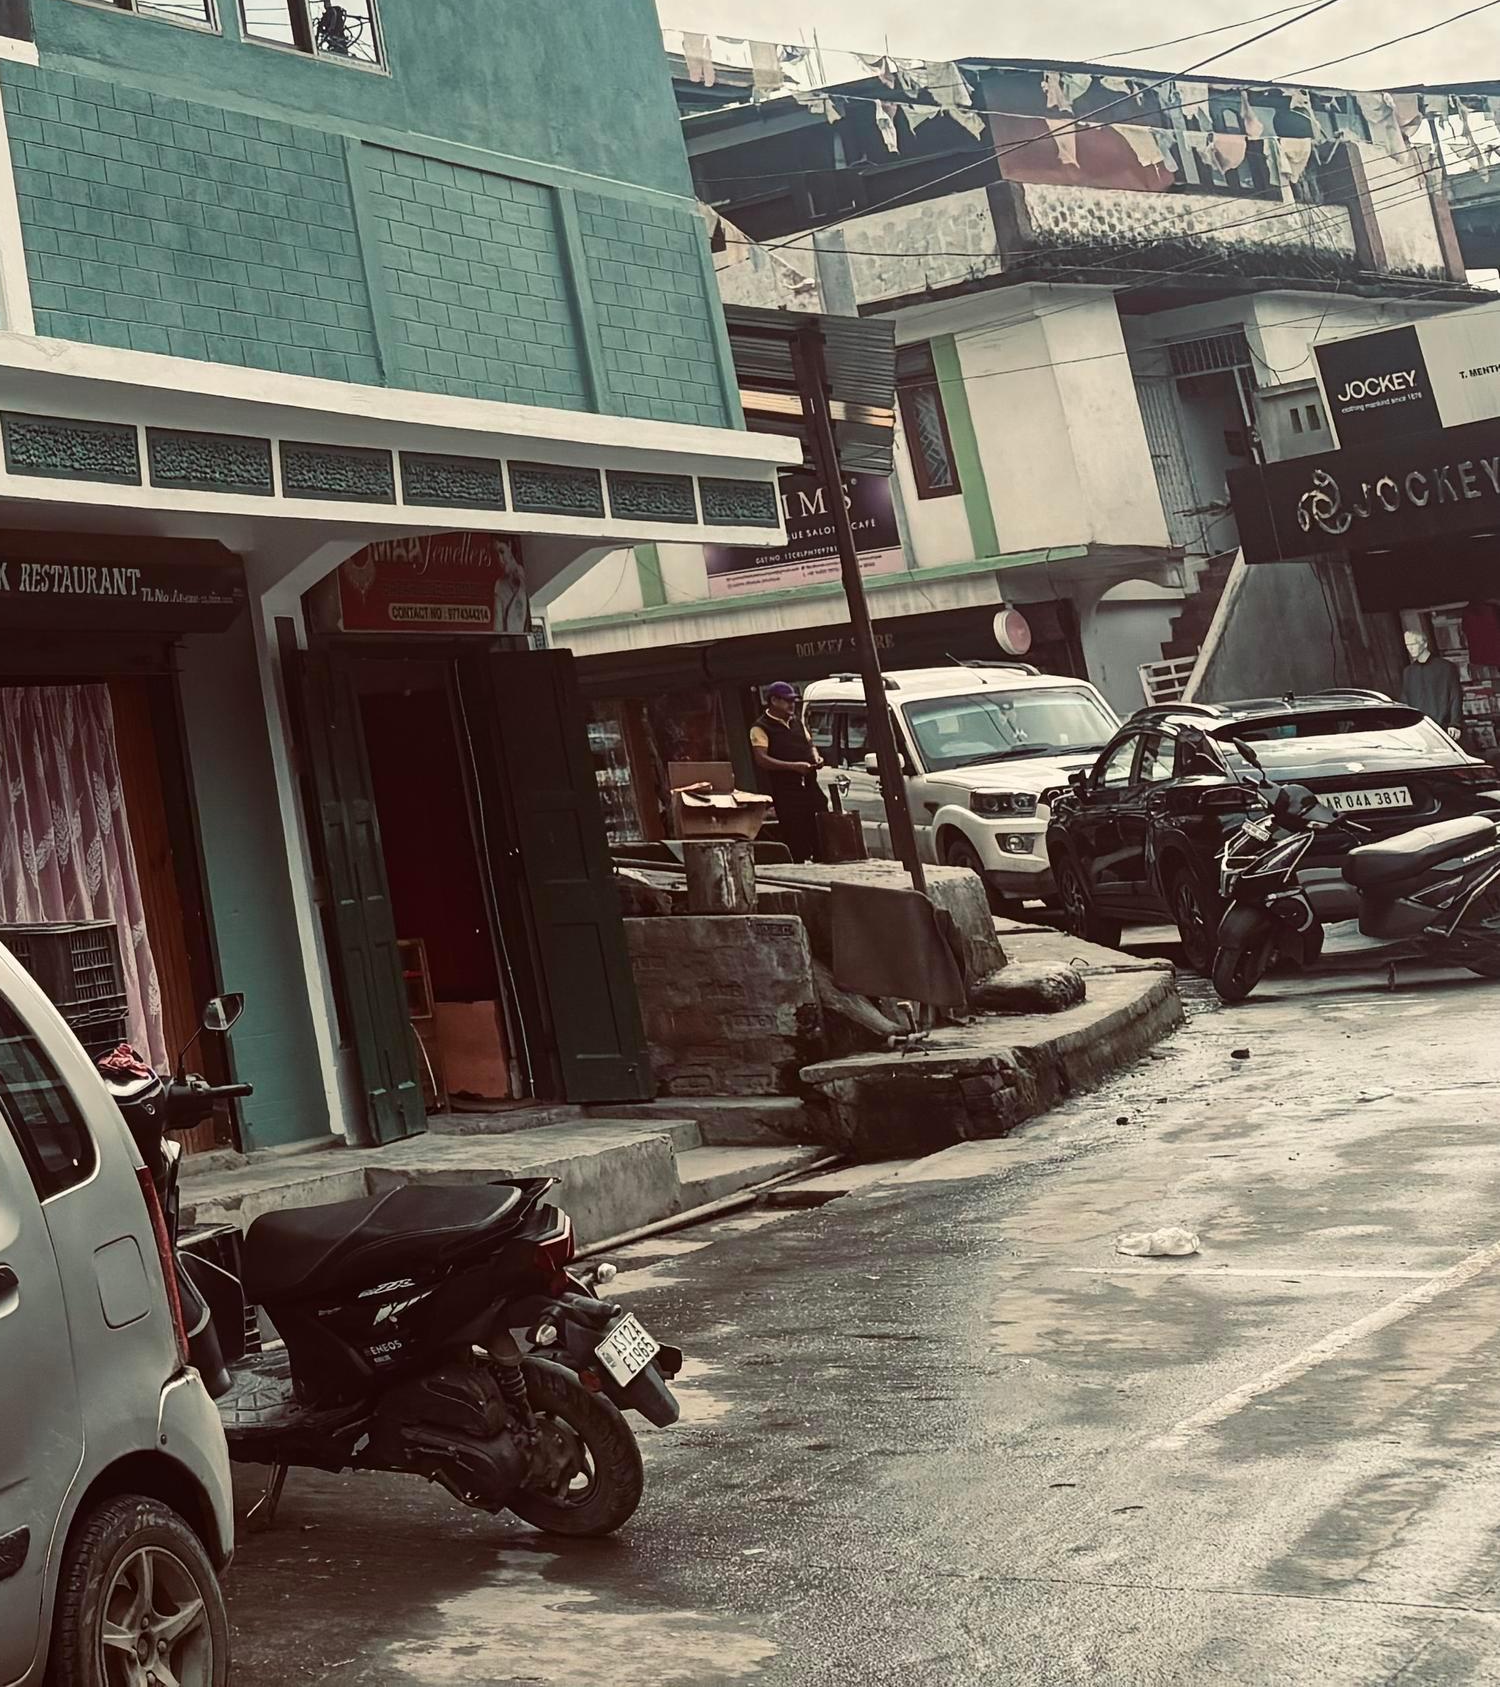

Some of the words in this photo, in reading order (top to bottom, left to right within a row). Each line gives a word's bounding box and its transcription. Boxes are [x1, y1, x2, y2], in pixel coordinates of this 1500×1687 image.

[1337, 369, 1416, 402] JOCKEY
[19, 562, 142, 597] RESTAURANT
[391, 606, 429, 620] CONTACT
[1374, 790, 1406, 806] 3817
[369, 1339, 403, 1356] ENEOS
[610, 1320, 642, 1356] AS12A
[622, 1337, 655, 1374] E1965
